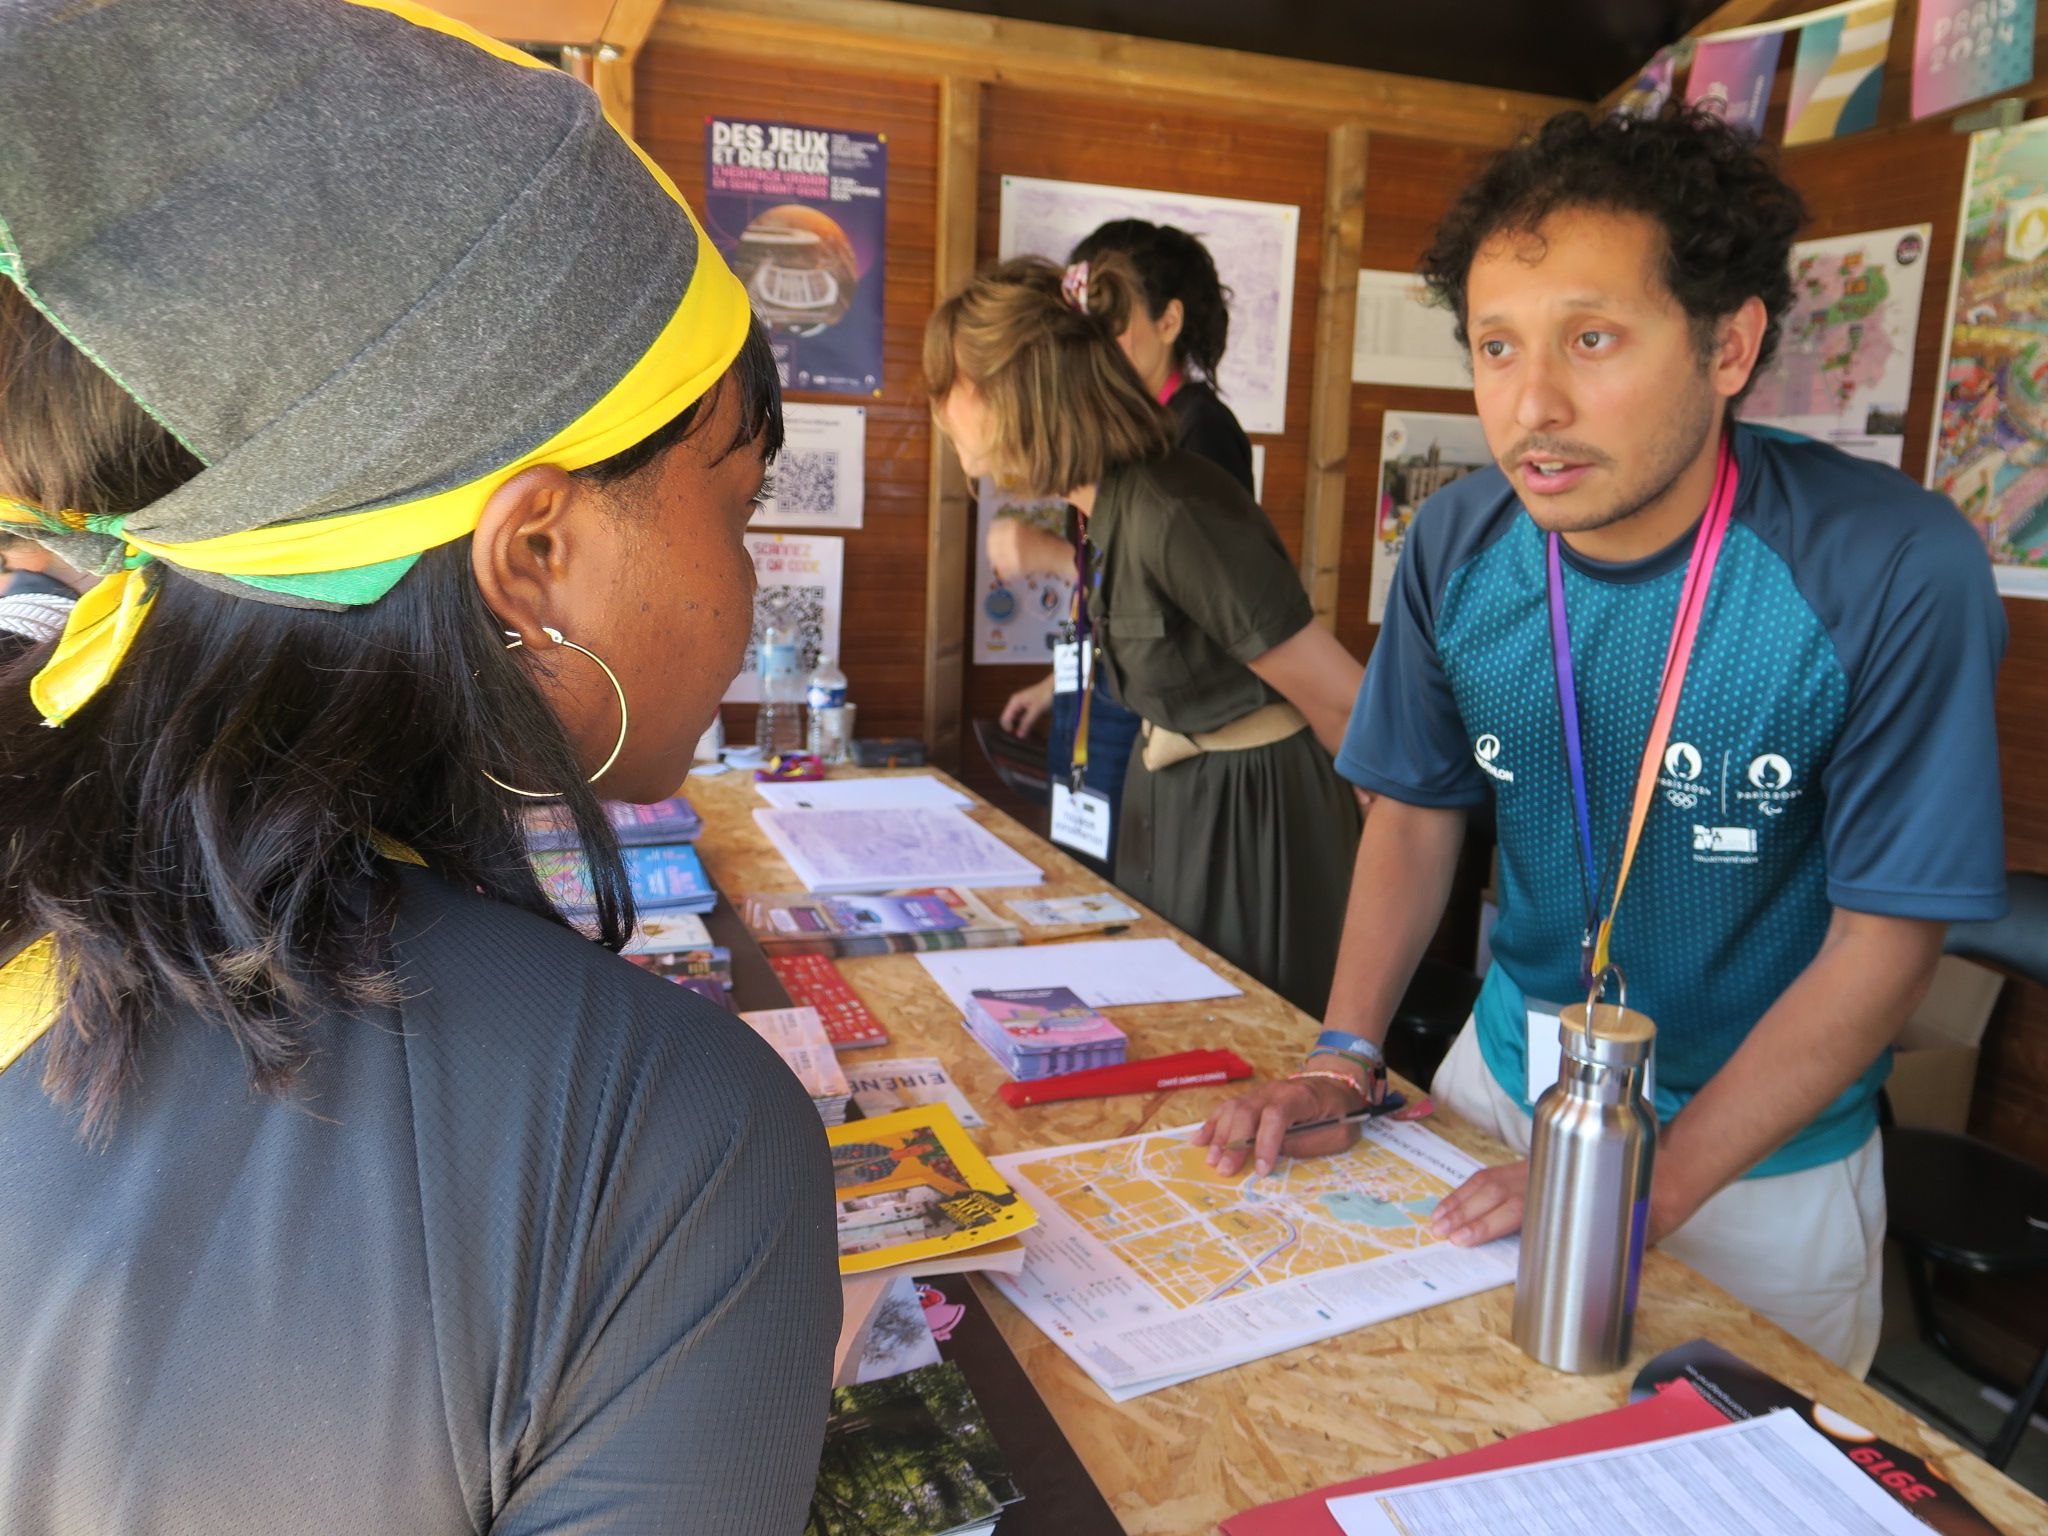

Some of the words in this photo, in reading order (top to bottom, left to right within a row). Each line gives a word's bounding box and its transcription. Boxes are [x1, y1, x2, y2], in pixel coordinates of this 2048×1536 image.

[1928, 23, 2015, 75] 2024
[712, 121, 765, 149] DES
[768, 126, 829, 155] JEUX
[712, 146, 735, 165] ET
[738, 149, 776, 170] DES
[778, 152, 829, 175] LIEUX
[1848, 1446, 1937, 1503] 3919
